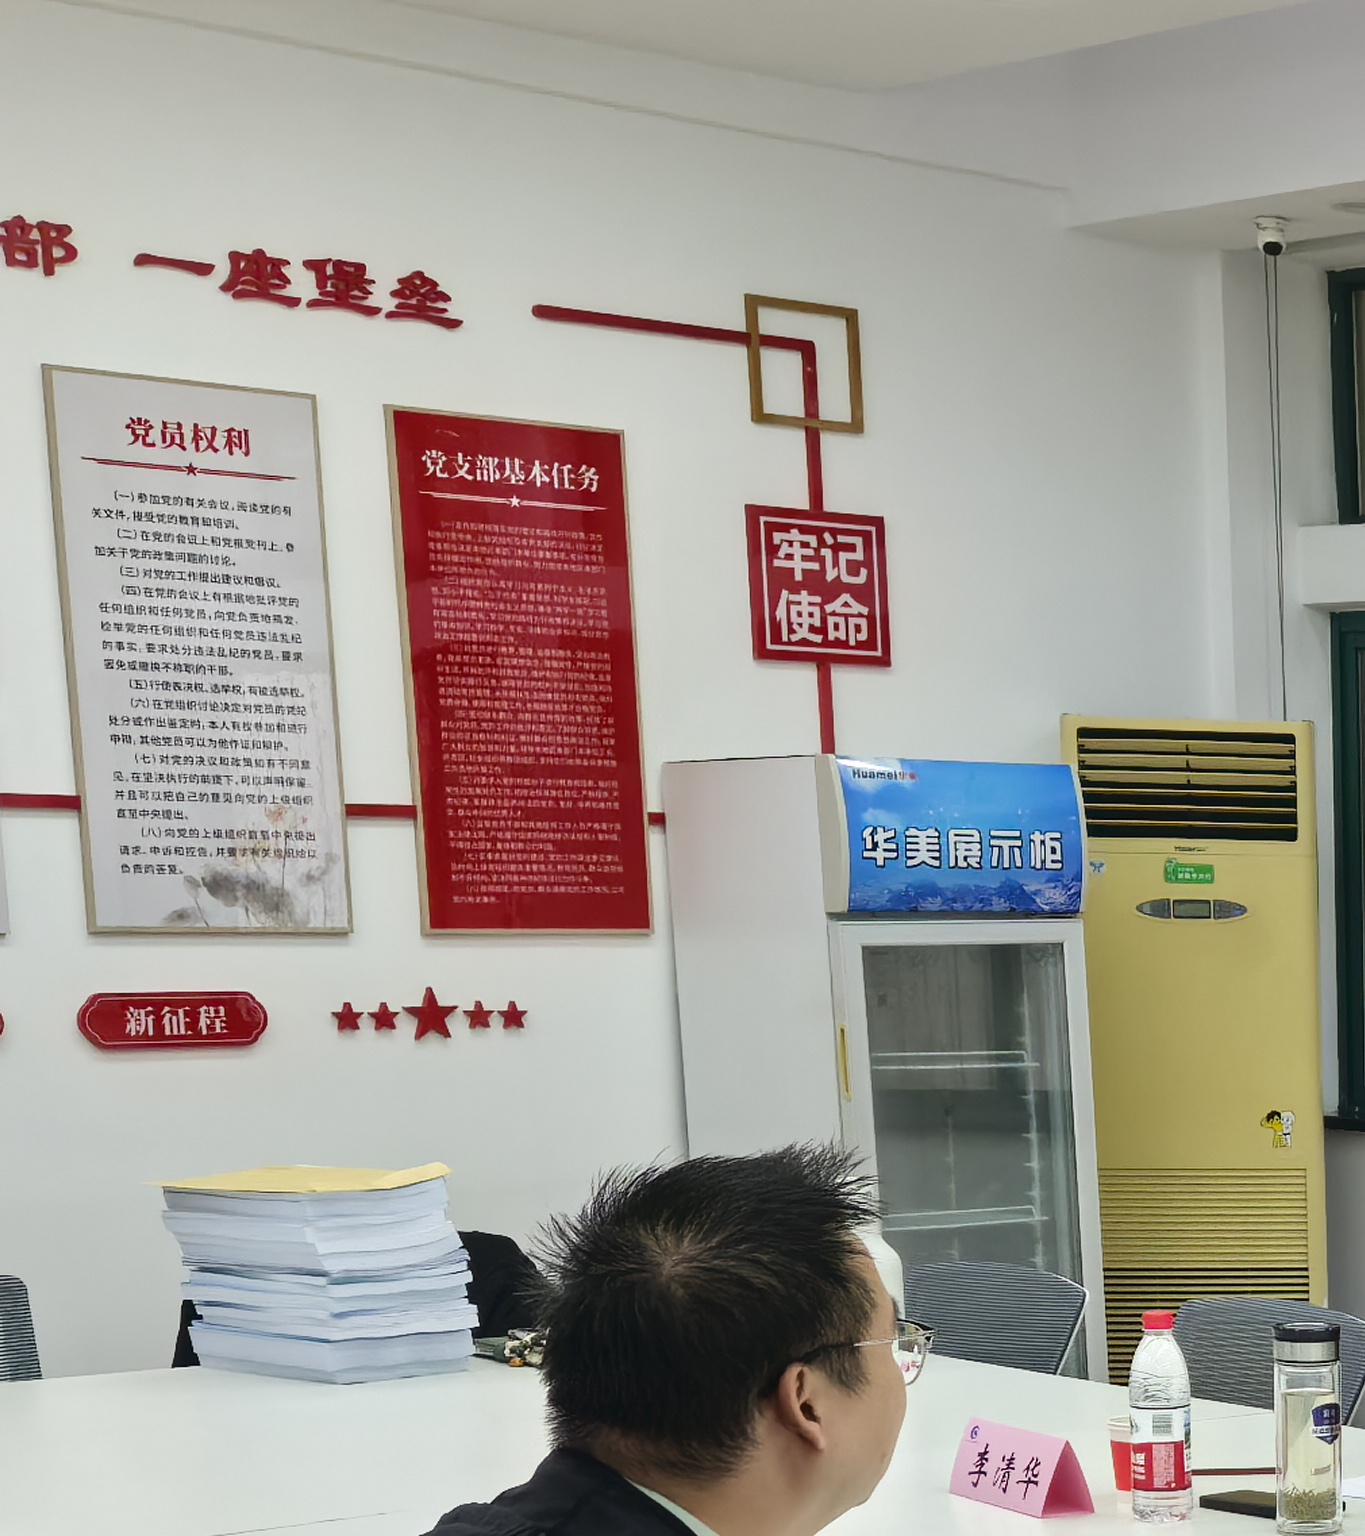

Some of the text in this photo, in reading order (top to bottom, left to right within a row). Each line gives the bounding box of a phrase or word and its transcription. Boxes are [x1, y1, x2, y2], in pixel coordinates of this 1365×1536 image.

[0, 215, 463, 329] 部 一座堡垒
[125, 417, 251, 457] 党员权利
[421, 449, 600, 493] 党支部基本任务
[772, 528, 868, 584] 牢记
[776, 588, 869, 647] 使命
[852, 768, 898, 780] Huamei
[862, 825, 1064, 870] 华美展示柜
[125, 1005, 228, 1036] 新征程
